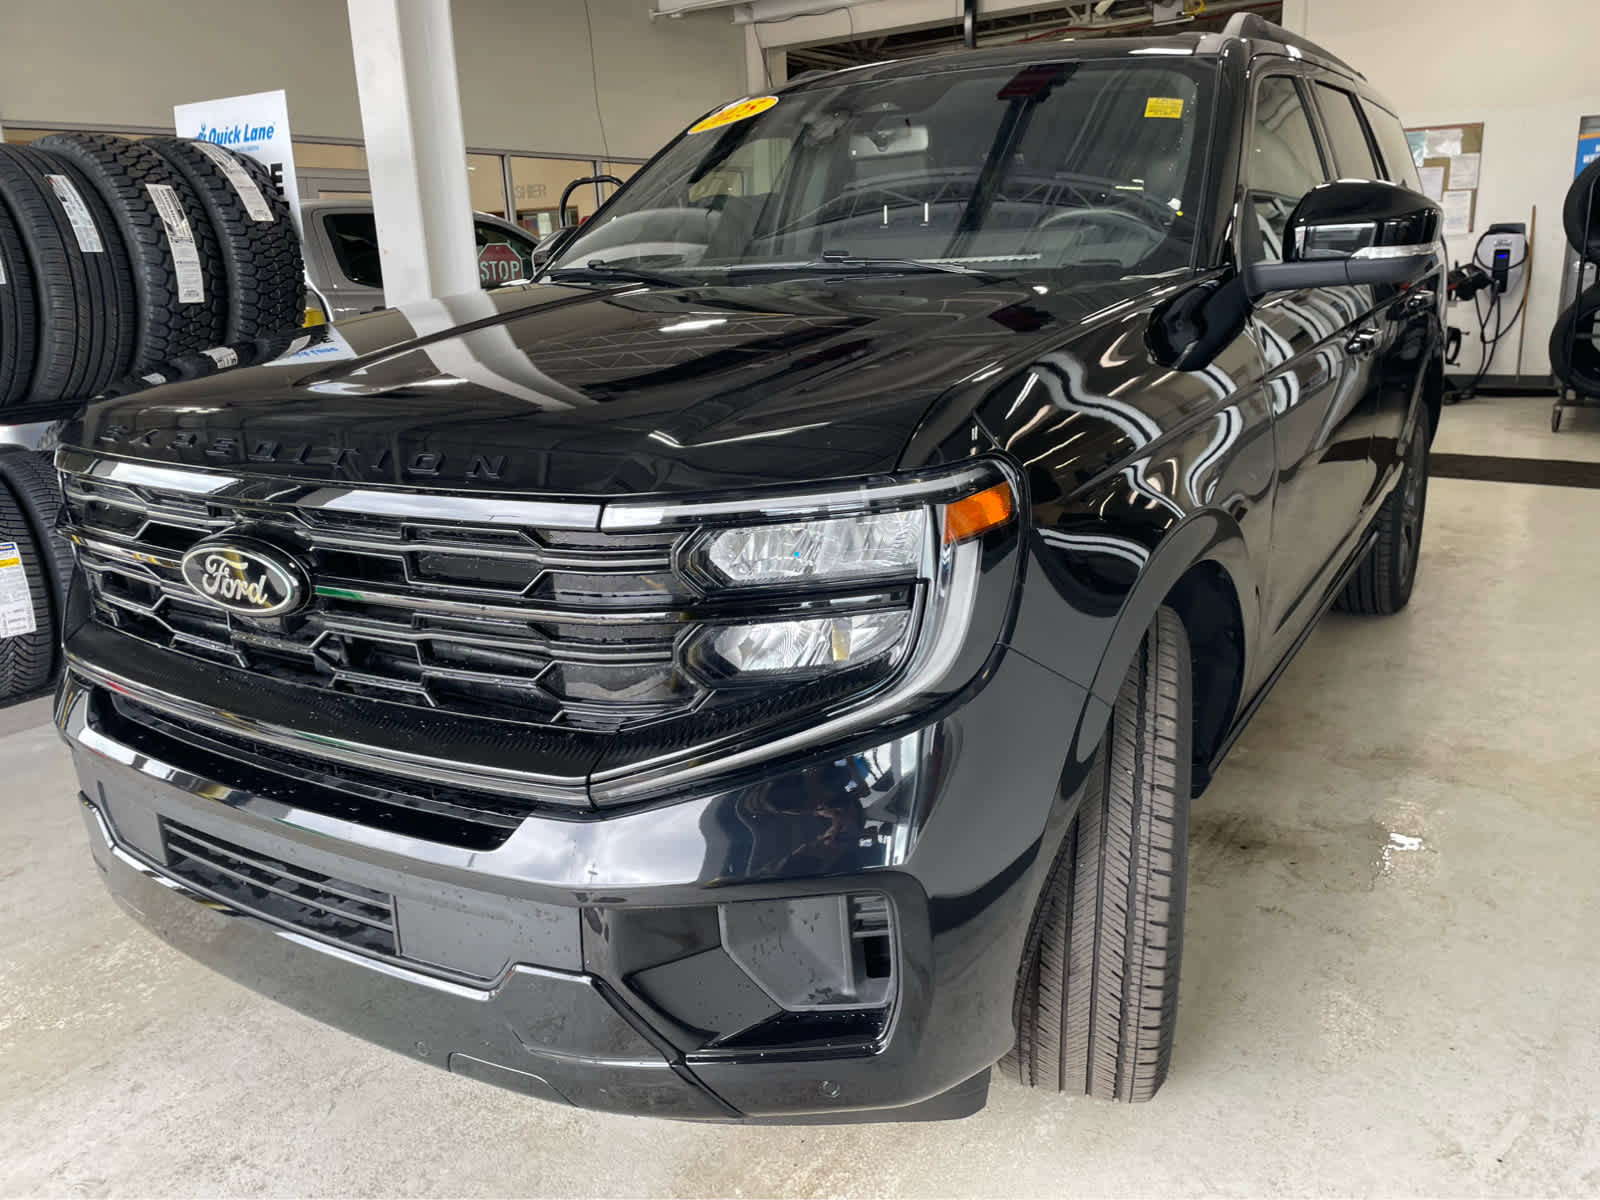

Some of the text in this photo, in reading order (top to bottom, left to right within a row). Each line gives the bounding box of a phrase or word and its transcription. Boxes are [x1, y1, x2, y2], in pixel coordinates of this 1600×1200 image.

[208, 123, 274, 145] Quick Lane
[480, 260, 520, 281] STOP
[202, 554, 268, 606] Ford
